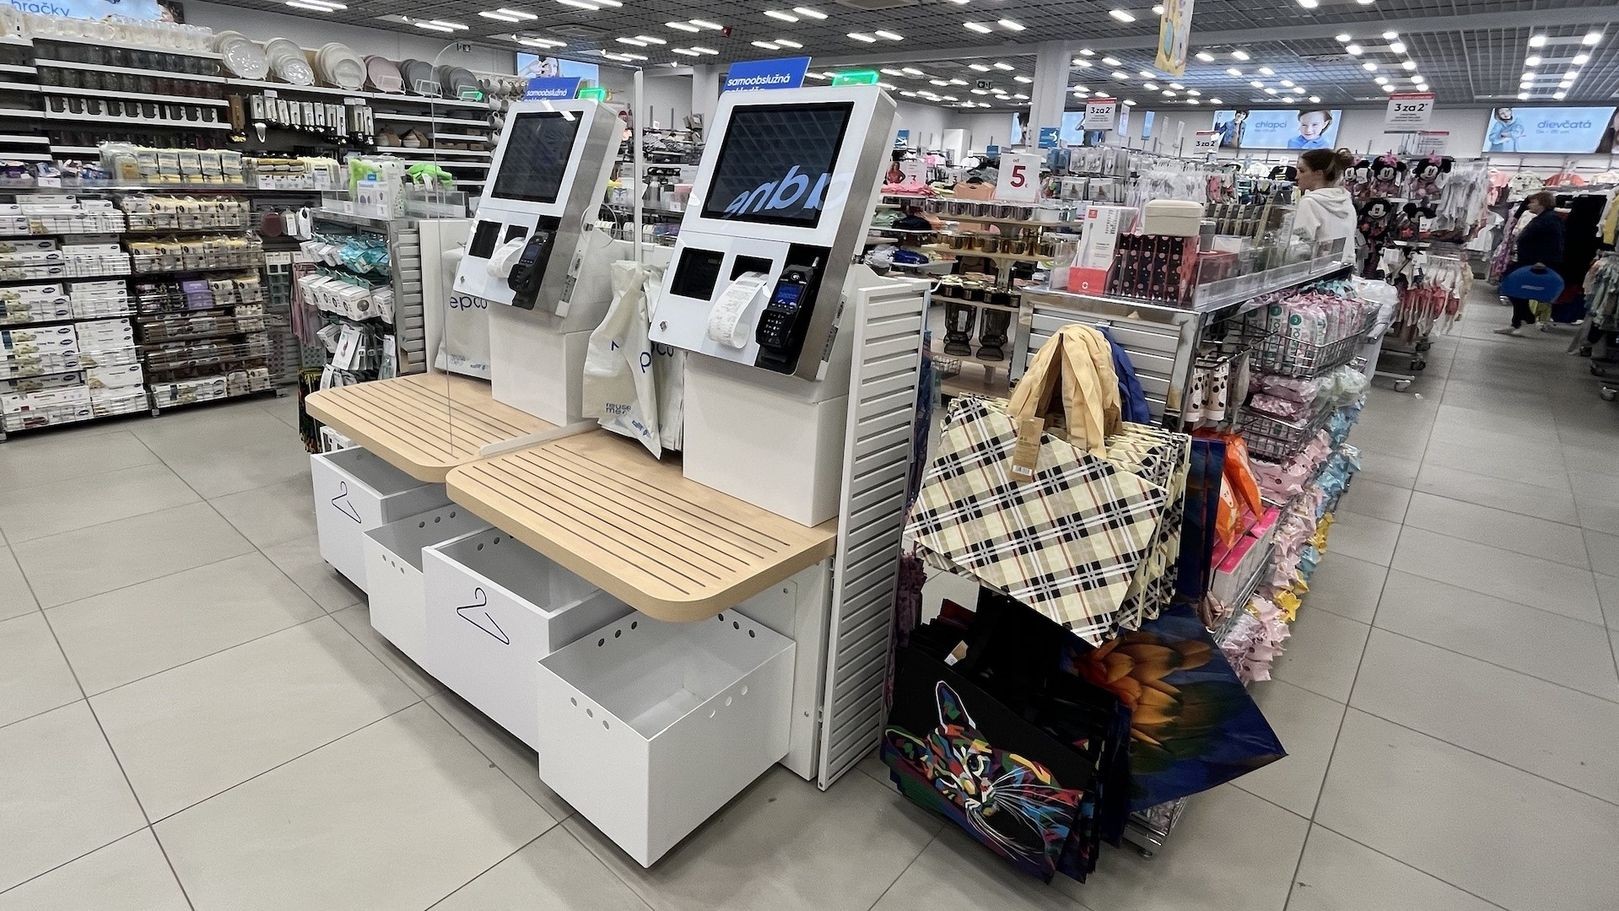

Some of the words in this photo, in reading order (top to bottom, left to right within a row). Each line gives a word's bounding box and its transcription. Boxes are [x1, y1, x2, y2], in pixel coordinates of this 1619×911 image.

[727, 73, 791, 87] samoobslužná
[1090, 106, 1096, 114] 3
[1394, 103, 1402, 112] 3
[1255, 121, 1288, 129] chlapci
[1537, 120, 1592, 129] dievčatá
[1010, 165, 1026, 188] 5
